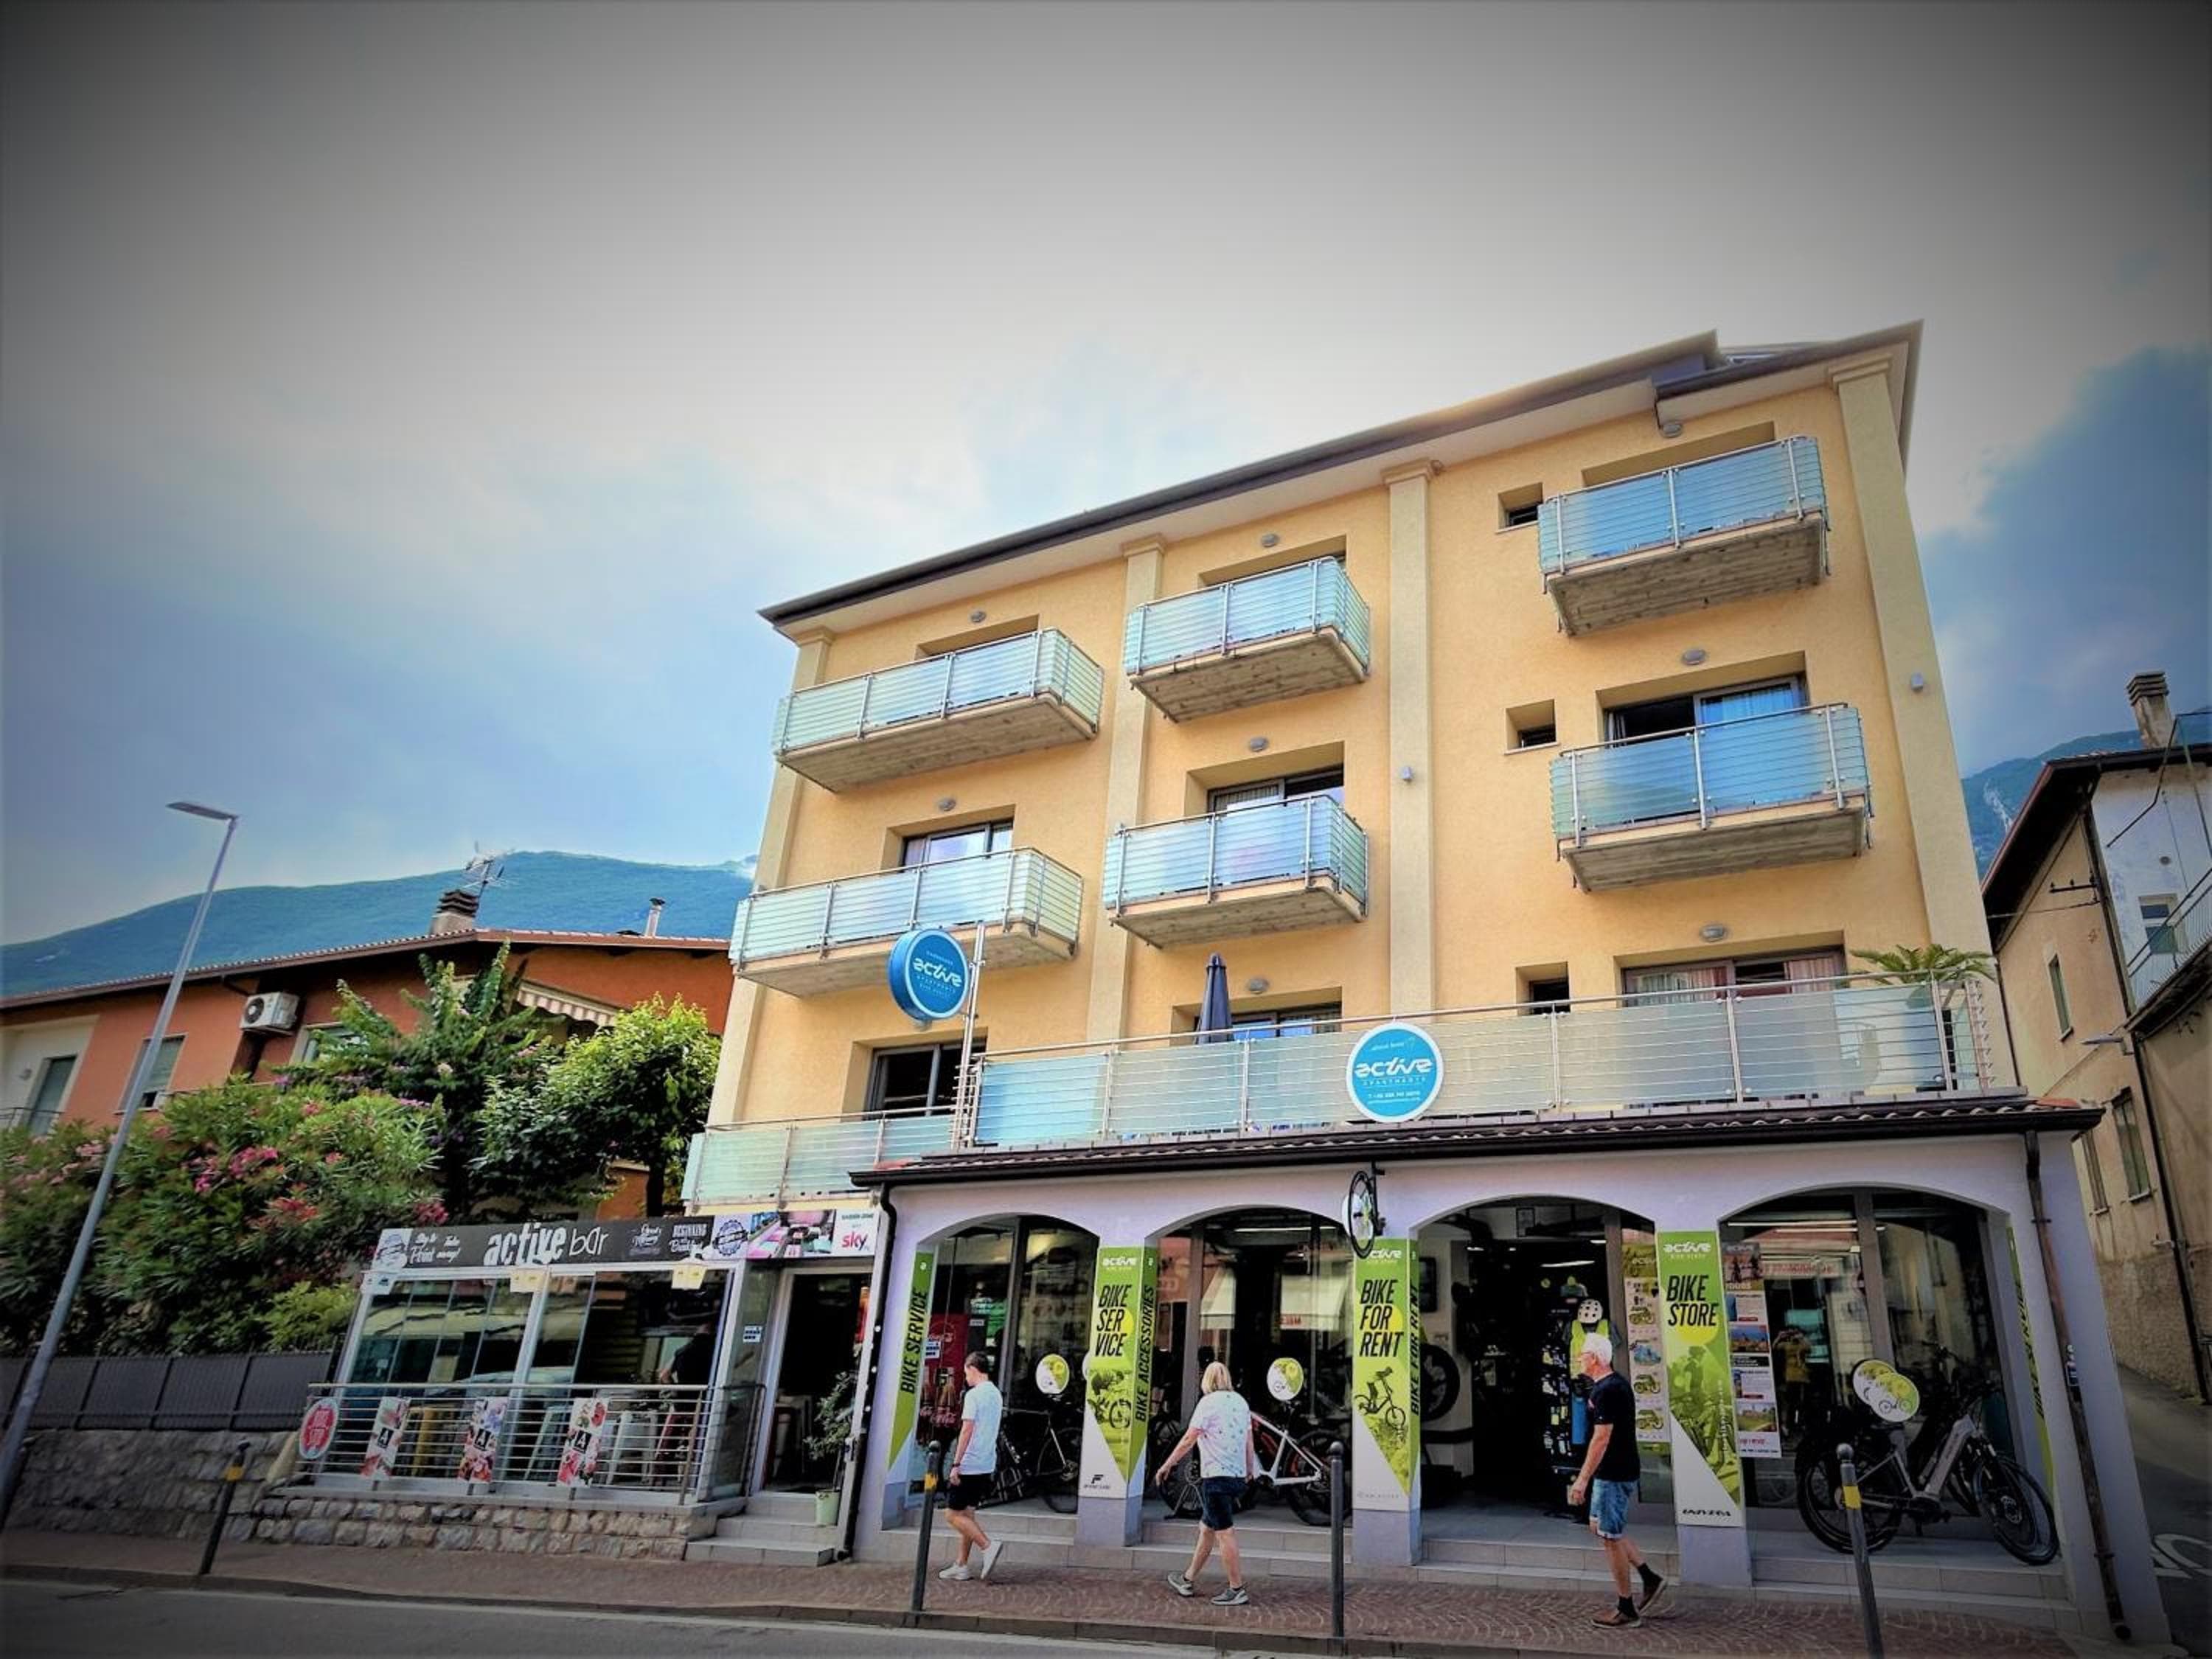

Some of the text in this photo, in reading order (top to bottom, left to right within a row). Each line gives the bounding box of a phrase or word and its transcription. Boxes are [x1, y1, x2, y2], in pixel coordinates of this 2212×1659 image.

[913, 957, 962, 987] active
[1354, 1056, 1433, 1078] active
[483, 1222, 610, 1266] active bar
[842, 1231, 869, 1251] sky
[1366, 1248, 1402, 1259] ctive
[1663, 1241, 1712, 1253] active
[1099, 1284, 1133, 1308] BIKE
[1360, 1279, 1398, 1304] BIKE
[1666, 1275, 1709, 1302] BIKE
[1096, 1309, 1125, 1332] SER
[1360, 1305, 1393, 1330] FOR
[1668, 1303, 1719, 1326] STORE
[900, 1287, 928, 1394] BIKE SERVICE
[1094, 1332, 1127, 1357] VICE
[1359, 1332, 1404, 1357] RENT
[1135, 1285, 1155, 1422] BIKE ACCESSORIES
[1411, 1376, 1419, 1416] BIKE
